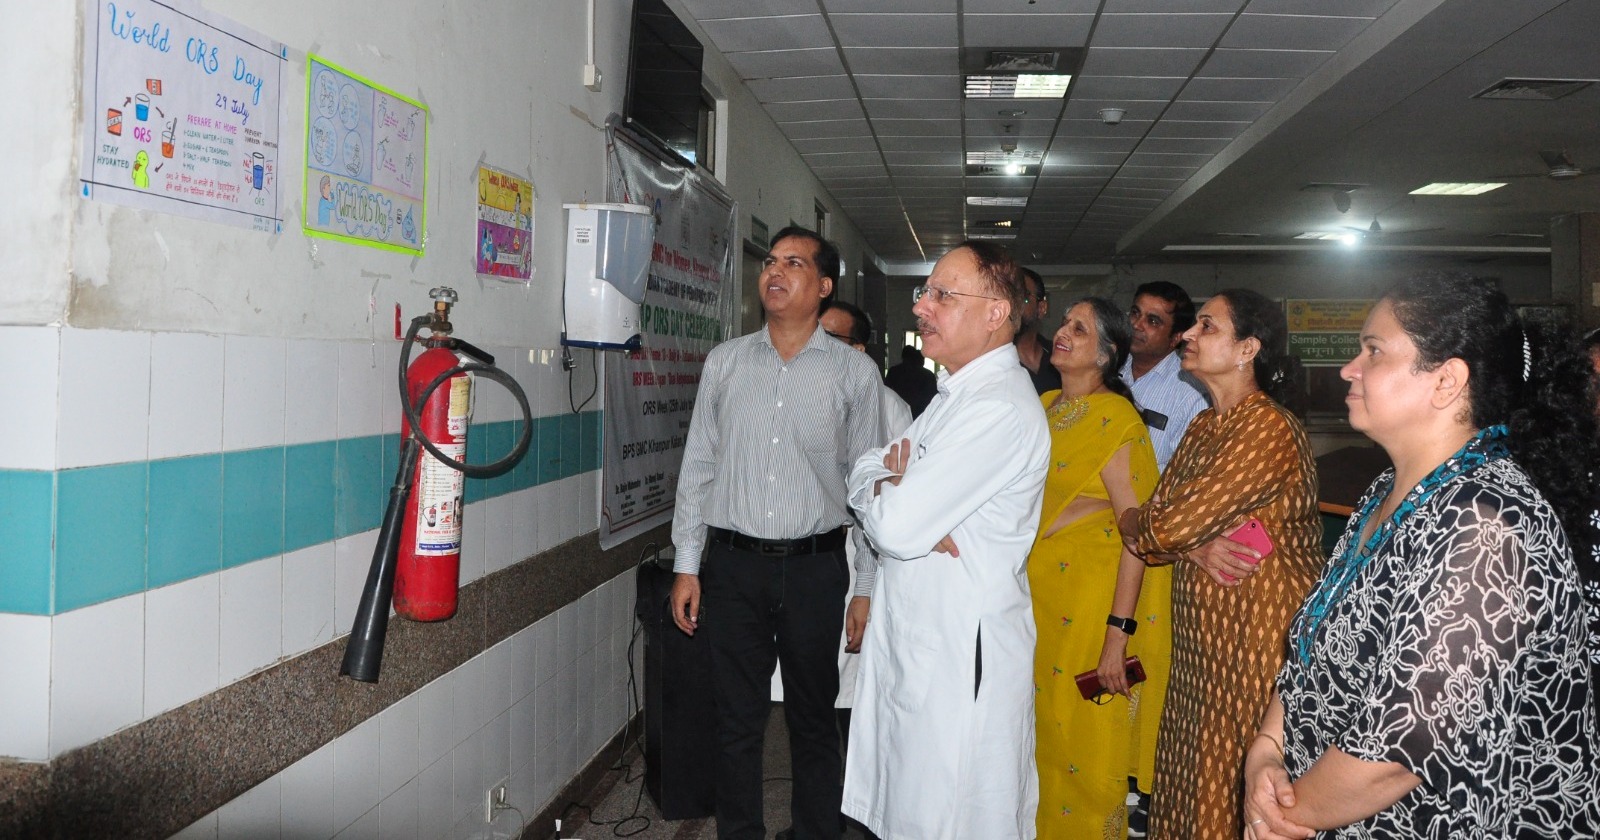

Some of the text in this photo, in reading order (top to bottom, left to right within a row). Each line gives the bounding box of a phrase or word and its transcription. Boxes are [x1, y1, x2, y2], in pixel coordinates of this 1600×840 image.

[108, 2, 264, 105] World ORS Day
[215, 93, 250, 125] 29 July
[134, 126, 151, 143] ORS
[214, 120, 222, 129] AT
[223, 123, 238, 135] HOME
[103, 144, 119, 155] STAY
[97, 155, 130, 169] HYDRATED
[360, 194, 373, 222] ORS
[375, 200, 387, 234] Day
[640, 302, 651, 332] AP
[654, 305, 669, 336] ORS
[671, 308, 684, 338] DAY
[1291, 335, 1361, 346] Sample Collec
[1301, 347, 1334, 358] नमूना
[633, 371, 642, 387] ORS
[642, 400, 656, 416] ORS
[622, 443, 636, 460] BPS
[636, 440, 648, 456] GMC
